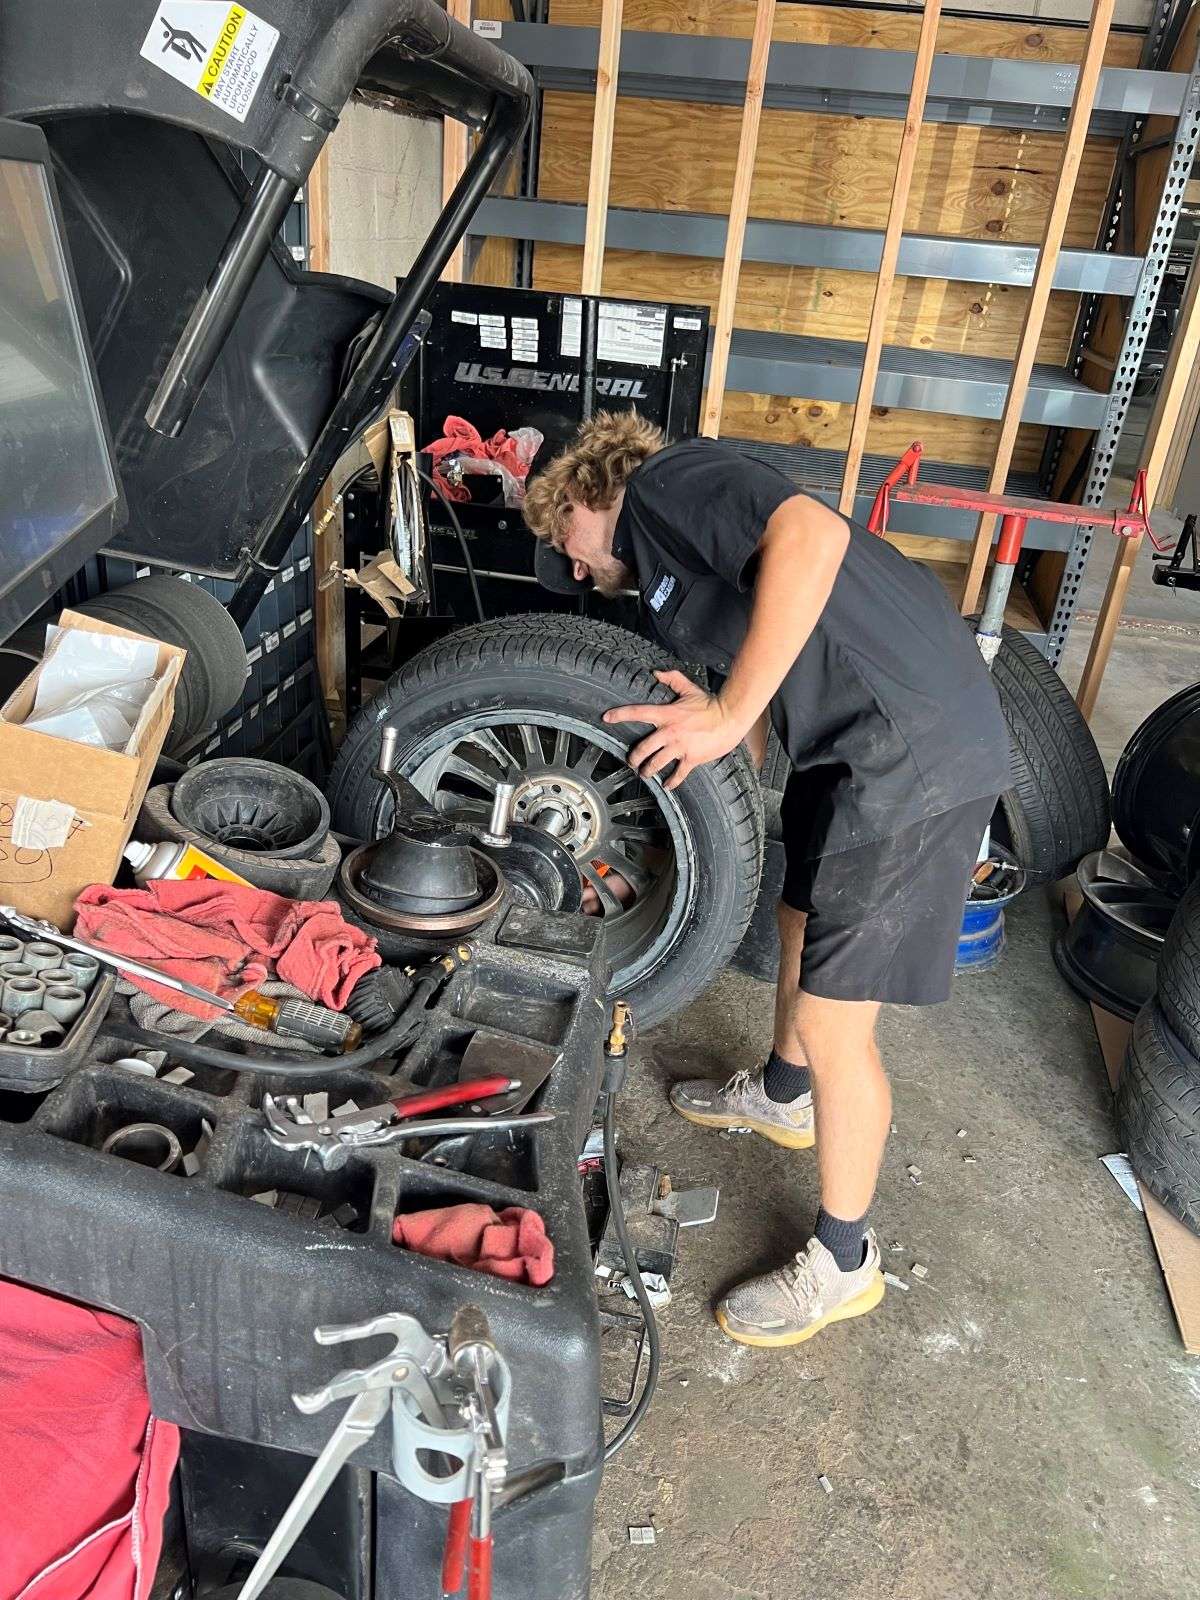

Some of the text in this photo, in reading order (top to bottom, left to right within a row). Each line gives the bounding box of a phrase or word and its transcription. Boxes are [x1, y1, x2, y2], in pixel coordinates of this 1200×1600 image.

[208, 11, 242, 77] CAUTION
[213, 45, 240, 100] MAY START
[221, 23, 259, 105] AUTOMATICALLY
[229, 50, 258, 110] UPON HOOD
[236, 71, 259, 114] CLOSING
